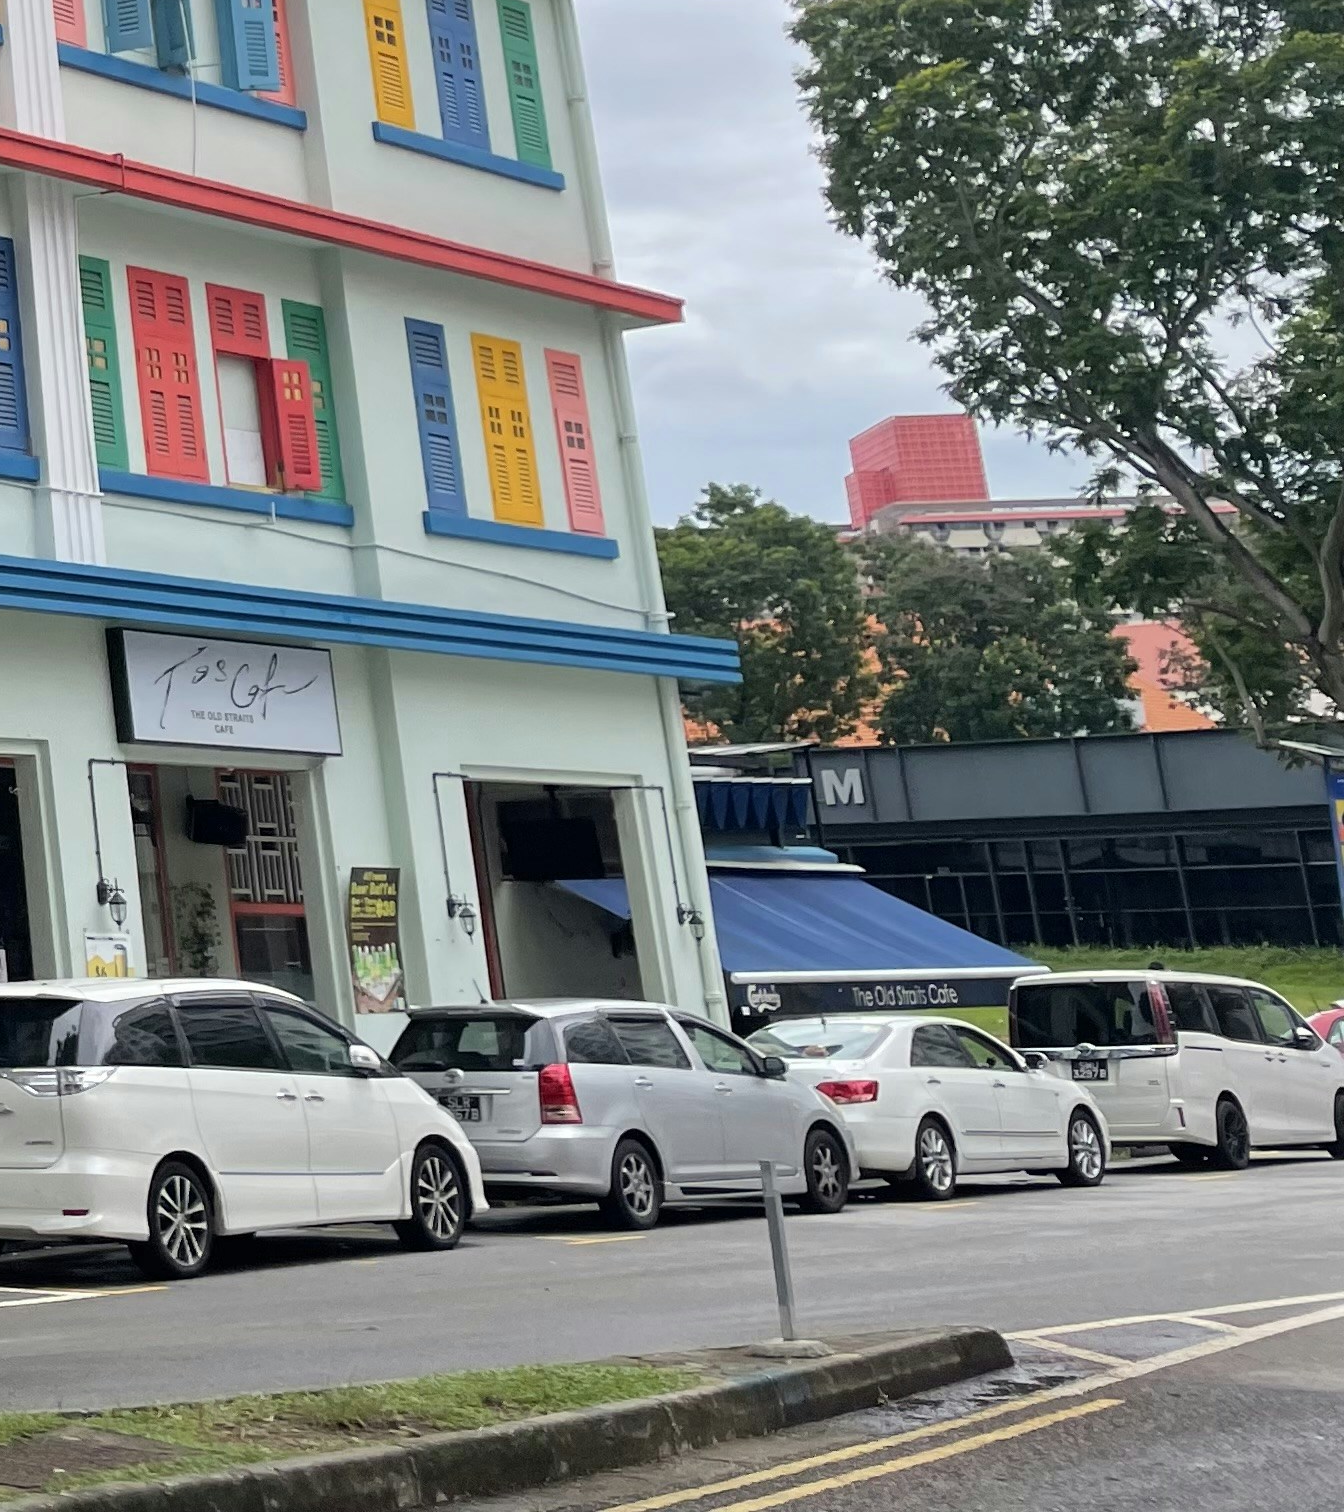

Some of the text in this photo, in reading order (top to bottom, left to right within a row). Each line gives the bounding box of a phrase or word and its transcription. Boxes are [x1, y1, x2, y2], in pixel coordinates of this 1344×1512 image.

[191, 710, 205, 720] THE
[207, 711, 222, 721] OLD
[214, 724, 234, 734] CAFE
[820, 768, 865, 805] M
[852, 983, 959, 1007] The Old Straits Cafe
